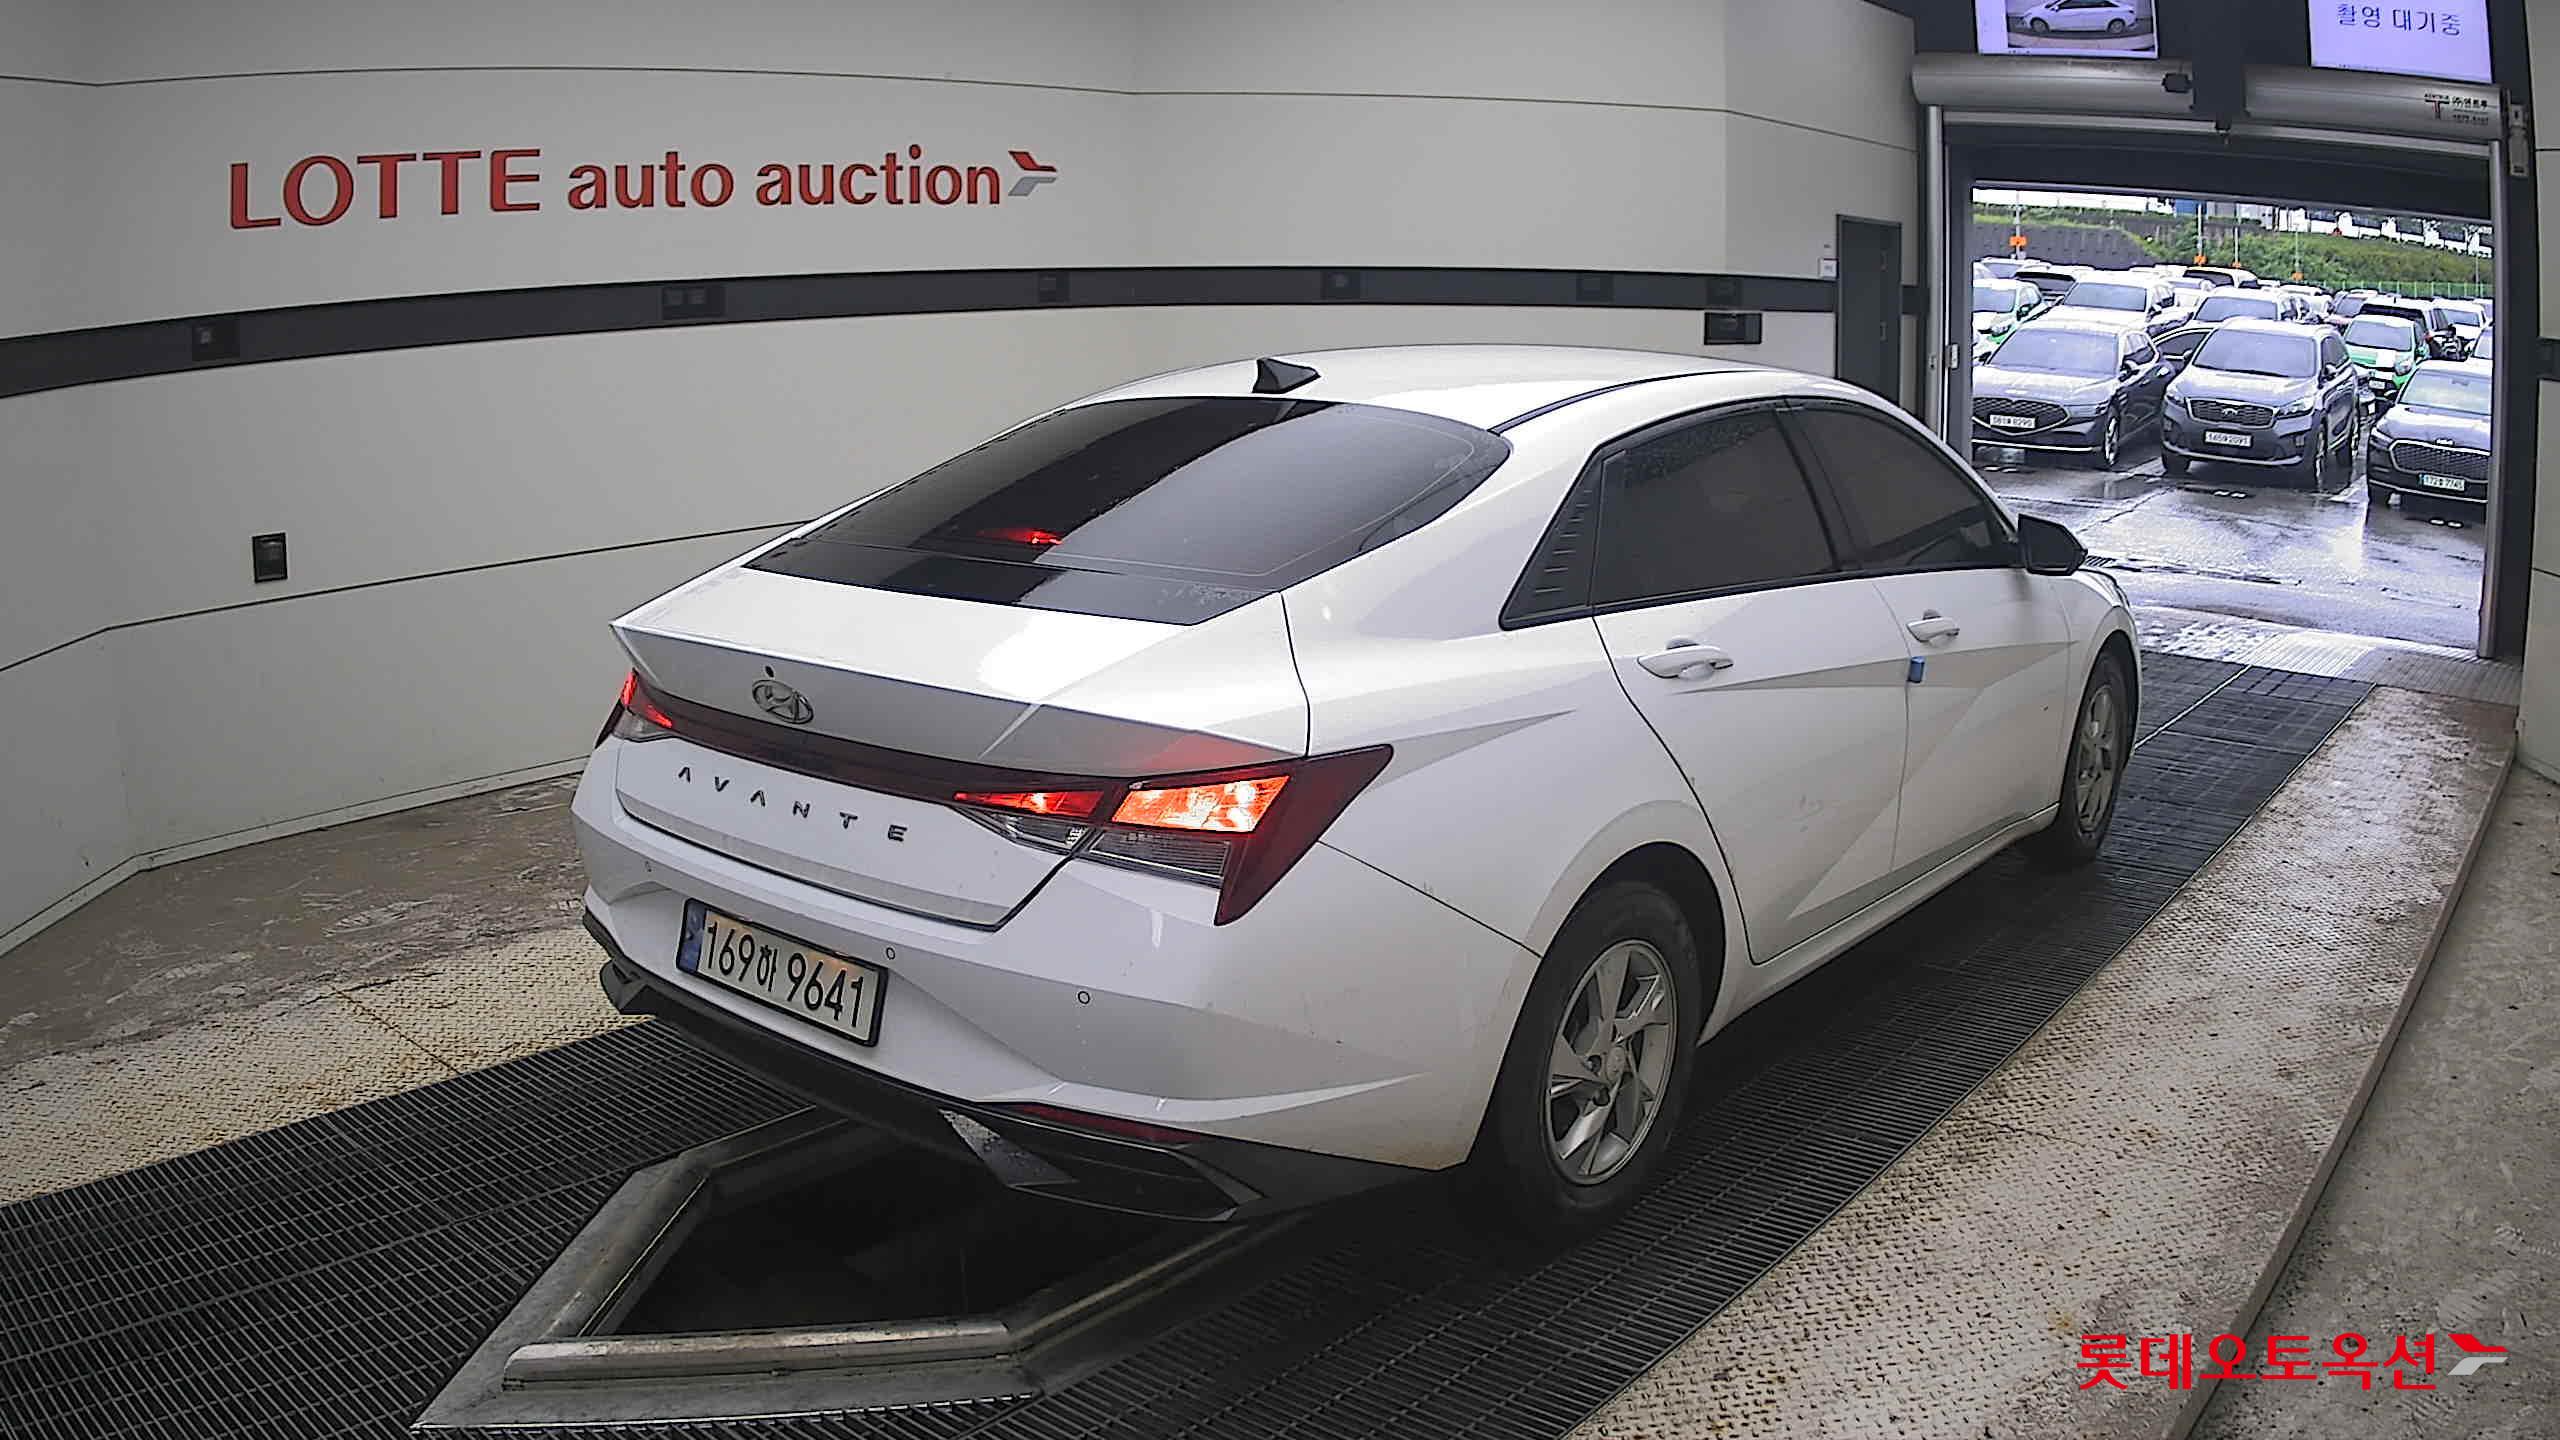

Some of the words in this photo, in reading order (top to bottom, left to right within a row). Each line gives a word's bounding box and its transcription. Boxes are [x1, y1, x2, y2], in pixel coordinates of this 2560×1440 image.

[2336, 3, 2381, 29] 촬영
[2392, 8, 2462, 37] 대기중
[231, 148, 539, 229] LOTTE
[569, 153, 735, 209] auto
[757, 146, 1002, 206] auction
[677, 765, 909, 843] AVANTE
[707, 921, 778, 993] 169하
[786, 952, 865, 1028] 9641
